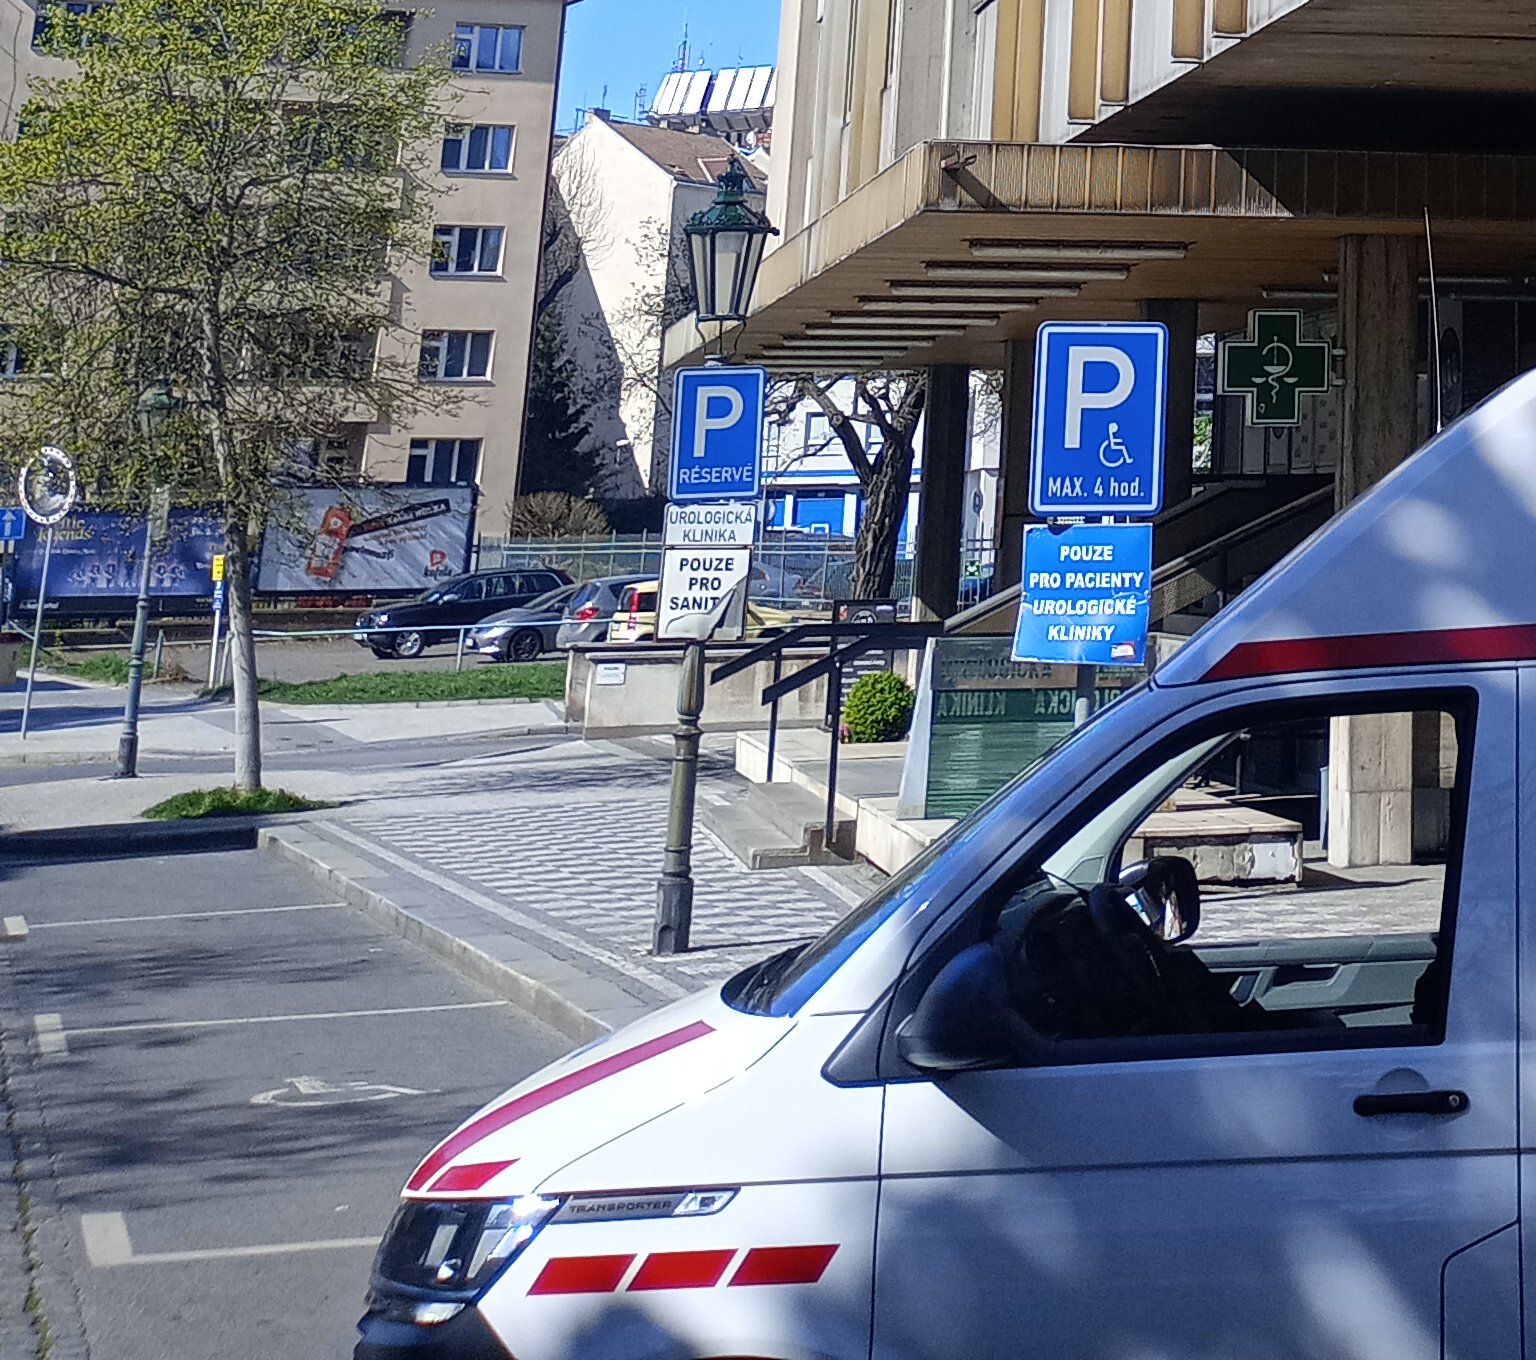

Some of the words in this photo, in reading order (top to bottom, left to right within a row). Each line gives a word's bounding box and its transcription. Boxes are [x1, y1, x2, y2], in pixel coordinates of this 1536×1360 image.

[1064, 345, 1135, 449] P
[693, 385, 744, 458] P
[679, 463, 753, 484] RÉSERVÉ
[1048, 476, 1088, 497] MAX.
[1093, 476, 1103, 497] 4
[1109, 476, 1145, 498] hod.
[669, 507, 752, 525] UROLOGICKÁ
[682, 528, 737, 542] KLINIKA
[1060, 545, 1113, 561] POUZE
[679, 557, 735, 572] POUZE
[688, 577, 722, 591] PRO
[1029, 572, 1061, 589] PRO
[1065, 571, 1144, 589] PACIENTY
[1033, 595, 1137, 615] UROLOGICKÉ
[1047, 625, 1115, 641] KLINIKY
[569, 1201, 672, 1214] TRANSPORTER
